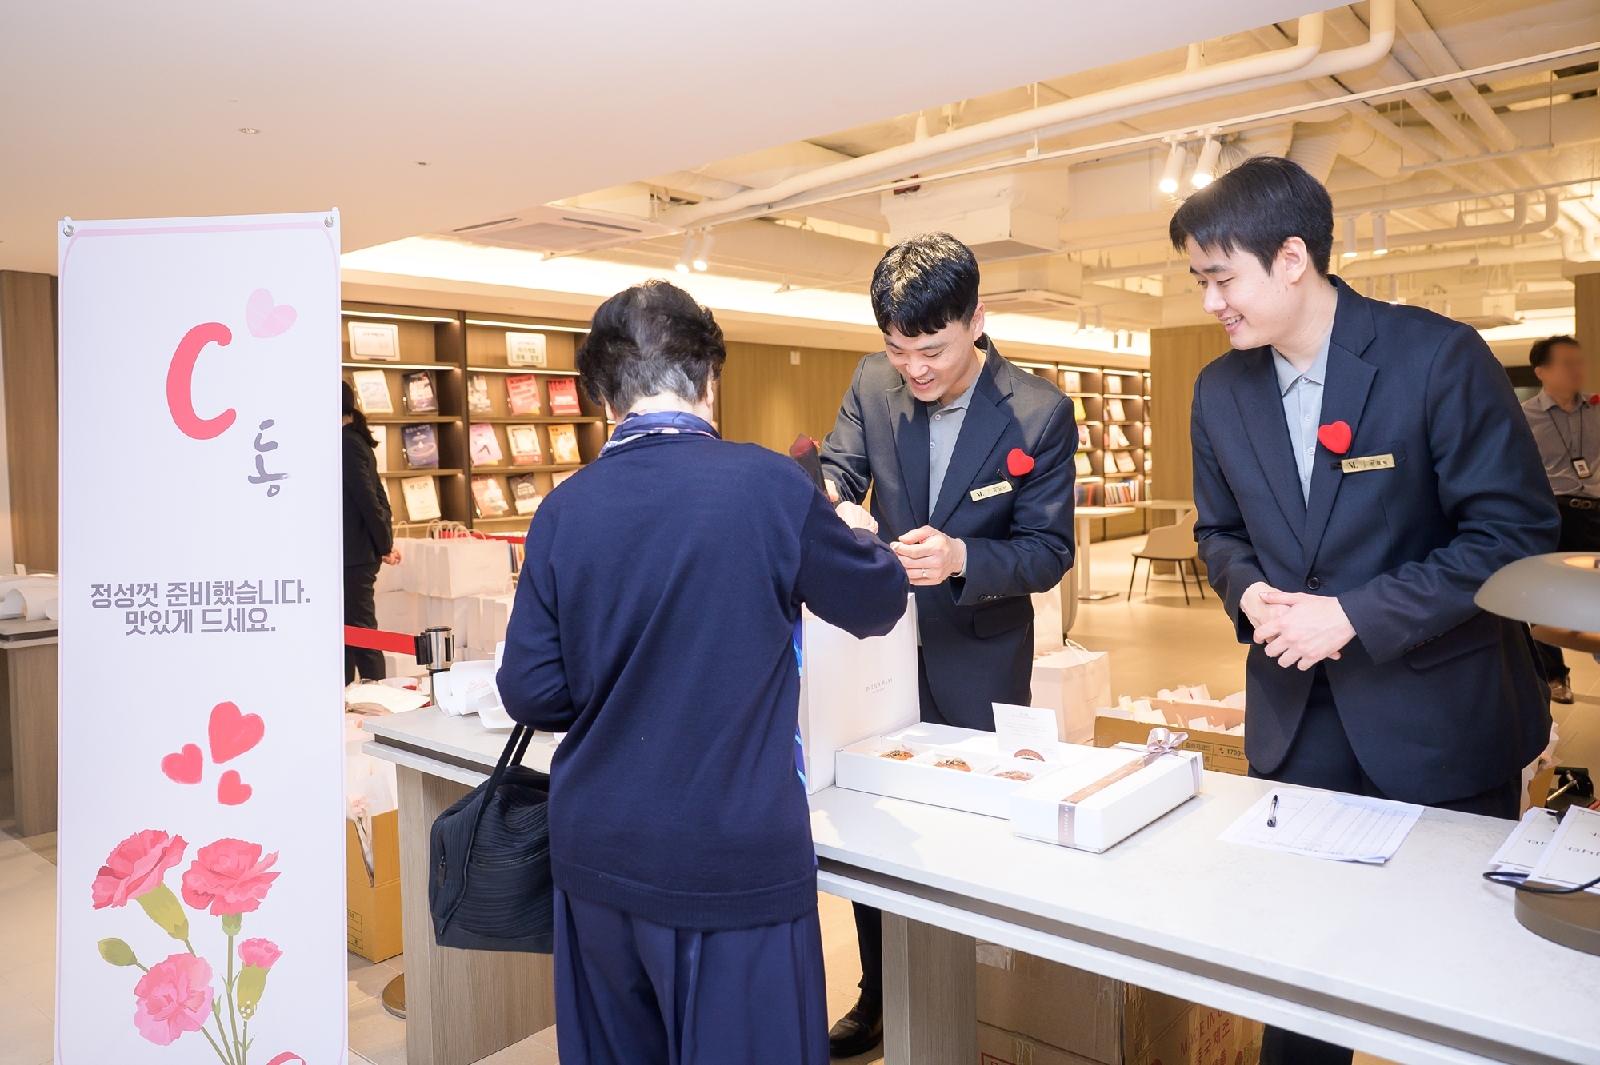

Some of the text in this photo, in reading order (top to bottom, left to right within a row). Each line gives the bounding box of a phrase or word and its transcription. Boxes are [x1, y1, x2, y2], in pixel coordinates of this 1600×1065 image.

[165, 322, 237, 440] C
[90, 579, 311, 608] 정성껏 준비했습니다.
[125, 607, 276, 636] 맛있게 드세요.
